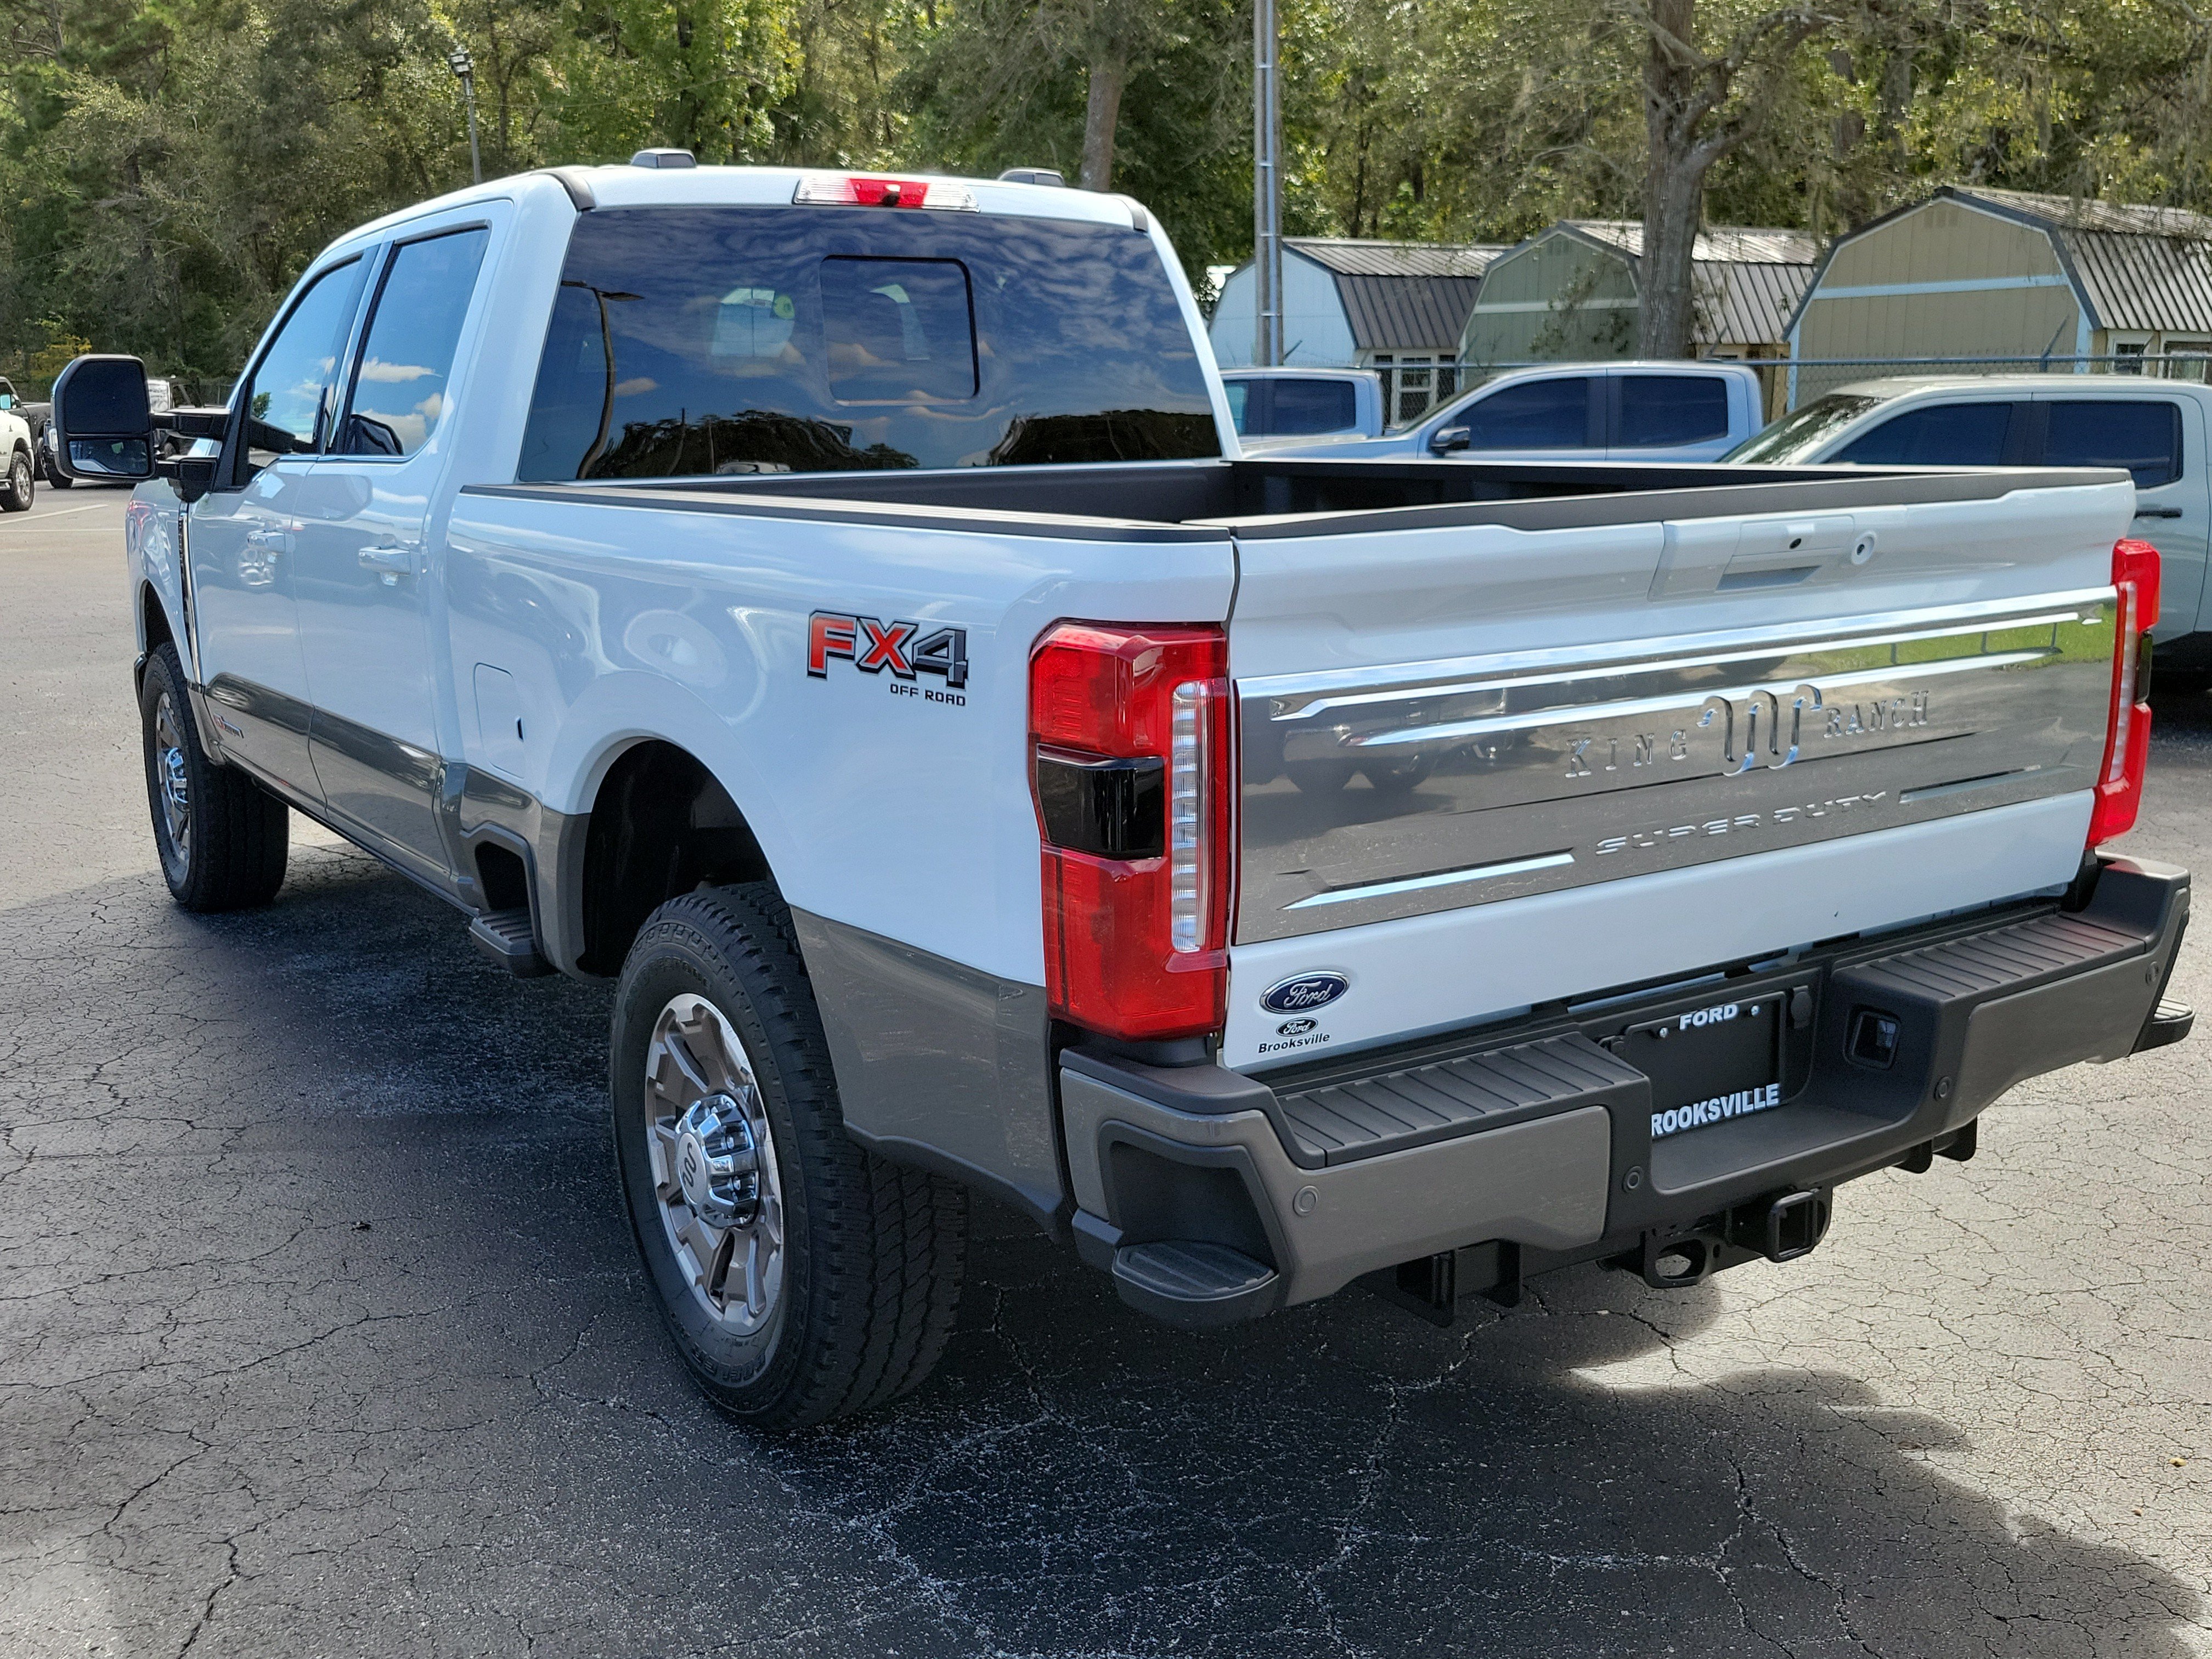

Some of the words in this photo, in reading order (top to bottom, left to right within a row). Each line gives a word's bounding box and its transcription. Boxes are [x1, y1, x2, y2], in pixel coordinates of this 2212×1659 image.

[807, 609, 969, 690] FX4
[890, 684, 919, 697] OFF
[924, 690, 966, 706] ROAD
[1565, 729, 1688, 778] KING
[1824, 690, 1929, 738] RANCH
[1595, 813, 1761, 856] SUPER
[1773, 791, 1887, 825] DUTY
[1283, 980, 1334, 1009] Ford
[1283, 1020, 1312, 1034] Ford
[1679, 1003, 1740, 1031] FORD
[1257, 1033, 1330, 1053] Brooksville
[1651, 1083, 1781, 1137] ROOKSVILLE
